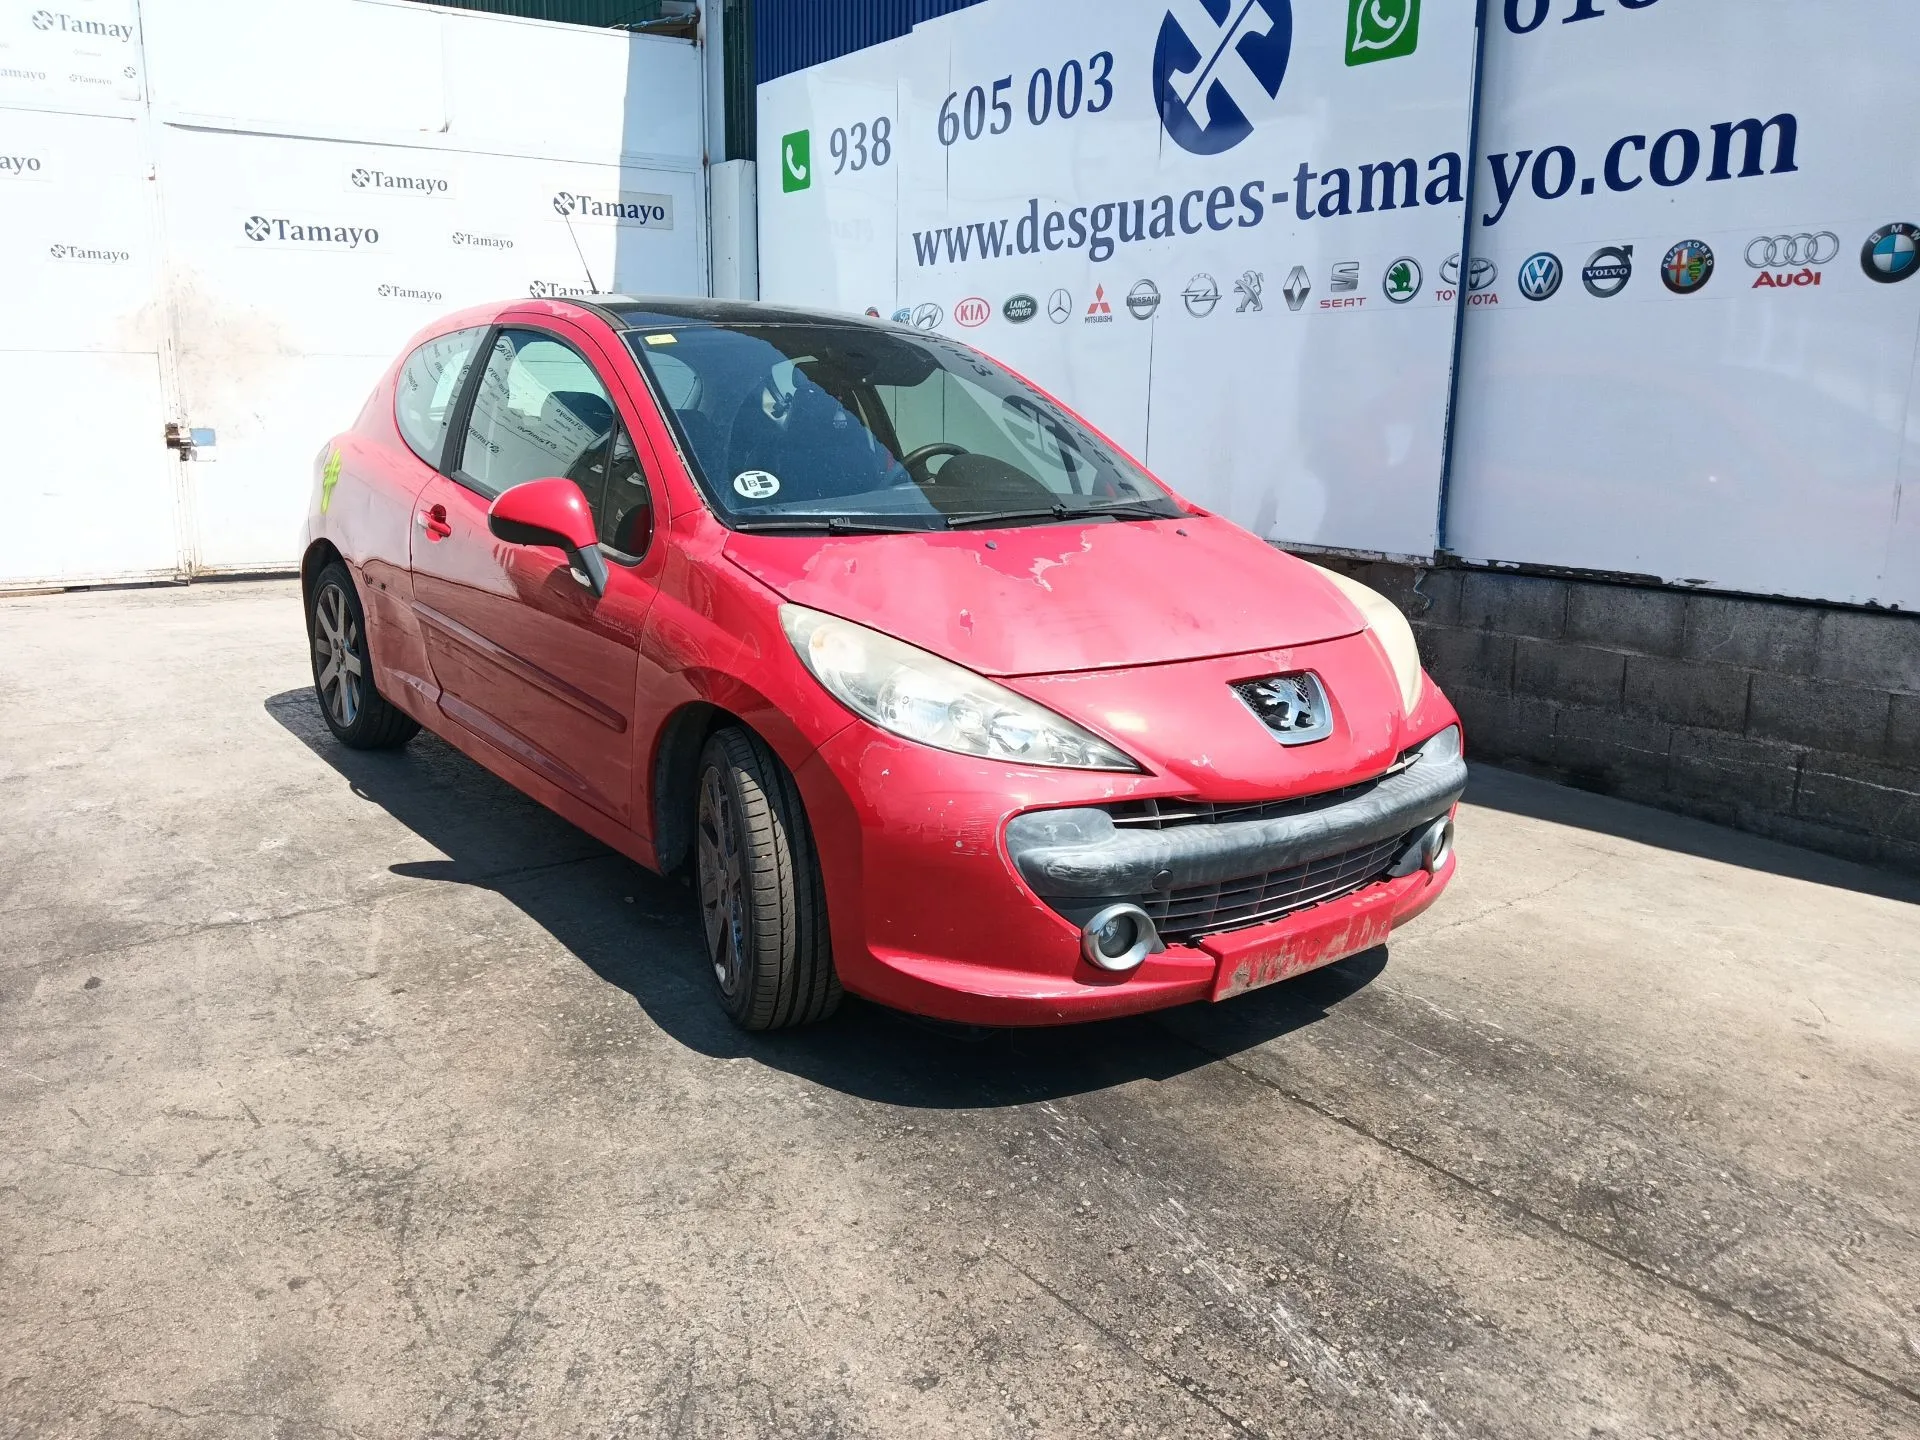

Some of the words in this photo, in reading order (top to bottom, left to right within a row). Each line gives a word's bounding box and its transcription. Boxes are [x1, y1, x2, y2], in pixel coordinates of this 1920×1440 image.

[830, 116, 892, 176] 938
[937, 74, 1013, 147] 605
[1027, 50, 1115, 128] 003
[371, 170, 449, 195] Tamayo
[576, 193, 666, 225] Tamayo
[272, 218, 380, 249] Tamayo
[465, 233, 514, 250] Tamayo
[1869, 223, 1920, 245] BMW
[67, 245, 130, 264] Tamayo
[1662, 246, 1680, 270] ALFA
[1687, 241, 1714, 268] ROMEO
[1586, 266, 1629, 278] VOLVO
[391, 285, 442, 301] Tamayo
[1129, 296, 1159, 305] NISSAN
[960, 302, 984, 322] KIA
[1009, 300, 1027, 309] LAND
[1010, 307, 1033, 317] ROVER
[1320, 297, 1367, 309] SEAT
[1084, 314, 1113, 325] MITSUBISHI
